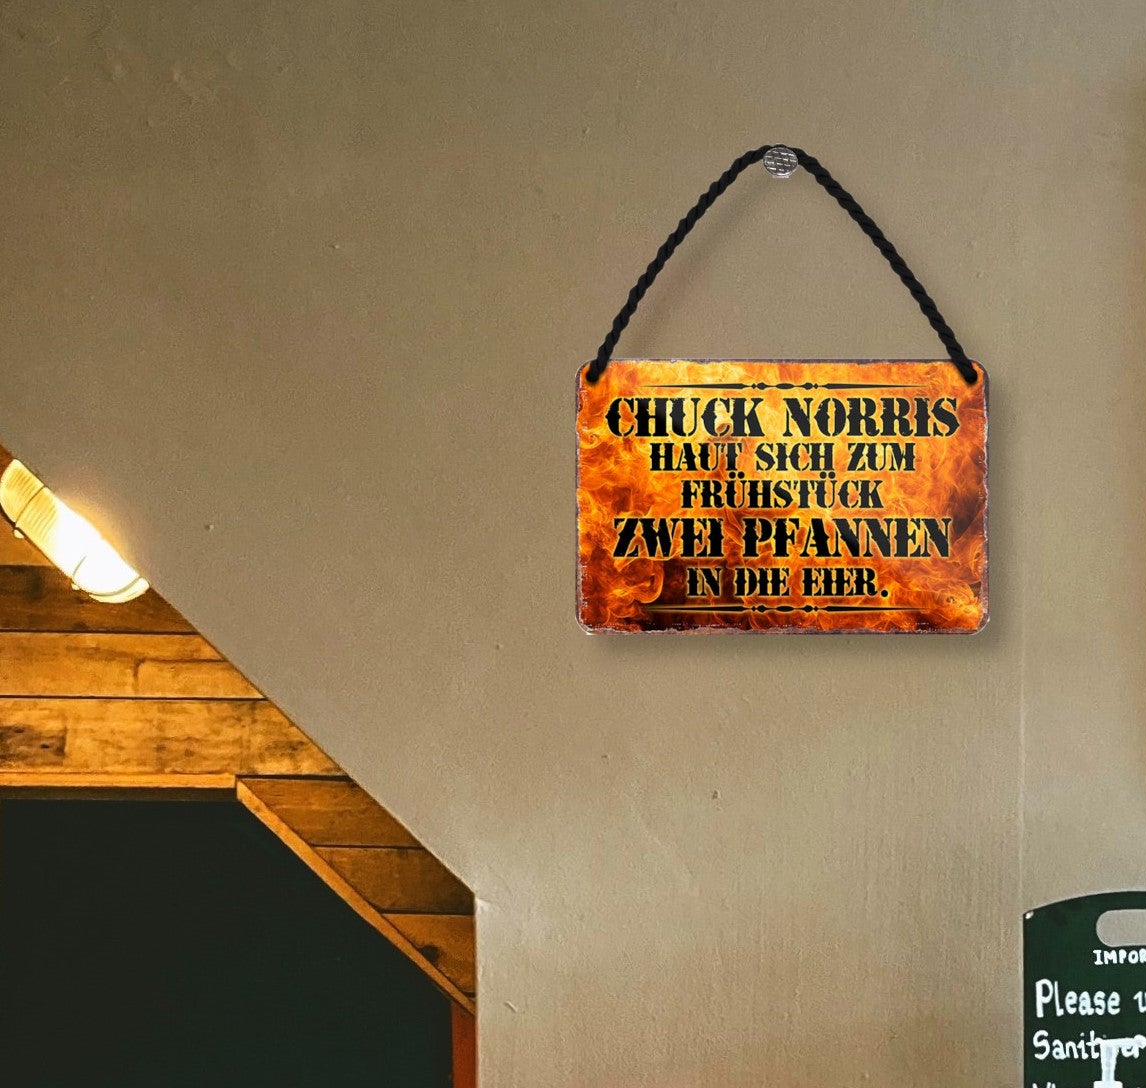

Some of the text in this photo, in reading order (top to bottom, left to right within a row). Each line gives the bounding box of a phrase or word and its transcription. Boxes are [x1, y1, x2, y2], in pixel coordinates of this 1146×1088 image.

[605, 397, 960, 437] CHUCK NORRIS
[649, 442, 915, 472] HAUT SICH ZUM
[681, 470, 883, 509] FRÜHSTÜCK
[613, 518, 952, 558] ZWEI PFANNEN
[685, 567, 889, 599] IN DIE EIER.
[1035, 978, 1121, 1018] Please
[1032, 1029, 1142, 1060] Saniter
